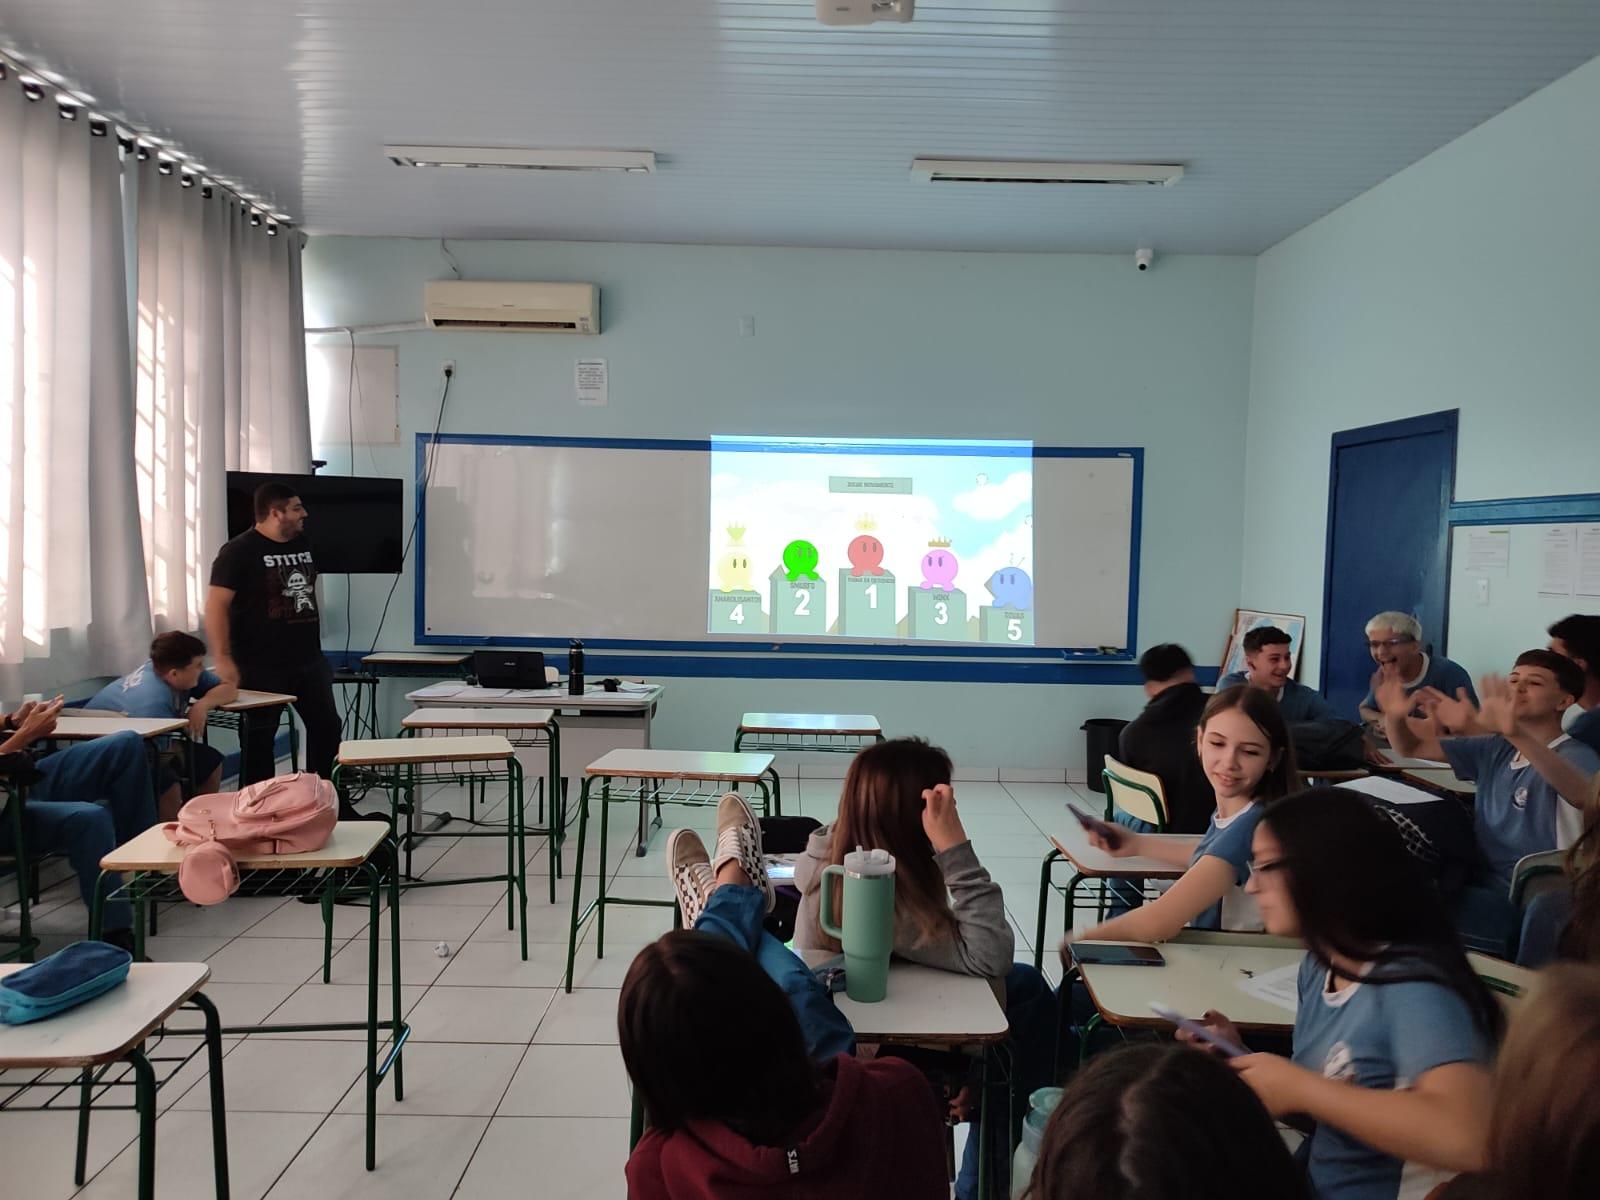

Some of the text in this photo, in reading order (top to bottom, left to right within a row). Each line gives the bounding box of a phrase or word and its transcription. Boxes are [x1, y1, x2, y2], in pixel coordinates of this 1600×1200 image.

[794, 588, 811, 616] 2
[864, 583, 878, 609] 1
[729, 603, 745, 625] 4
[934, 602, 949, 625] 3
[1007, 619, 1023, 641] 5
